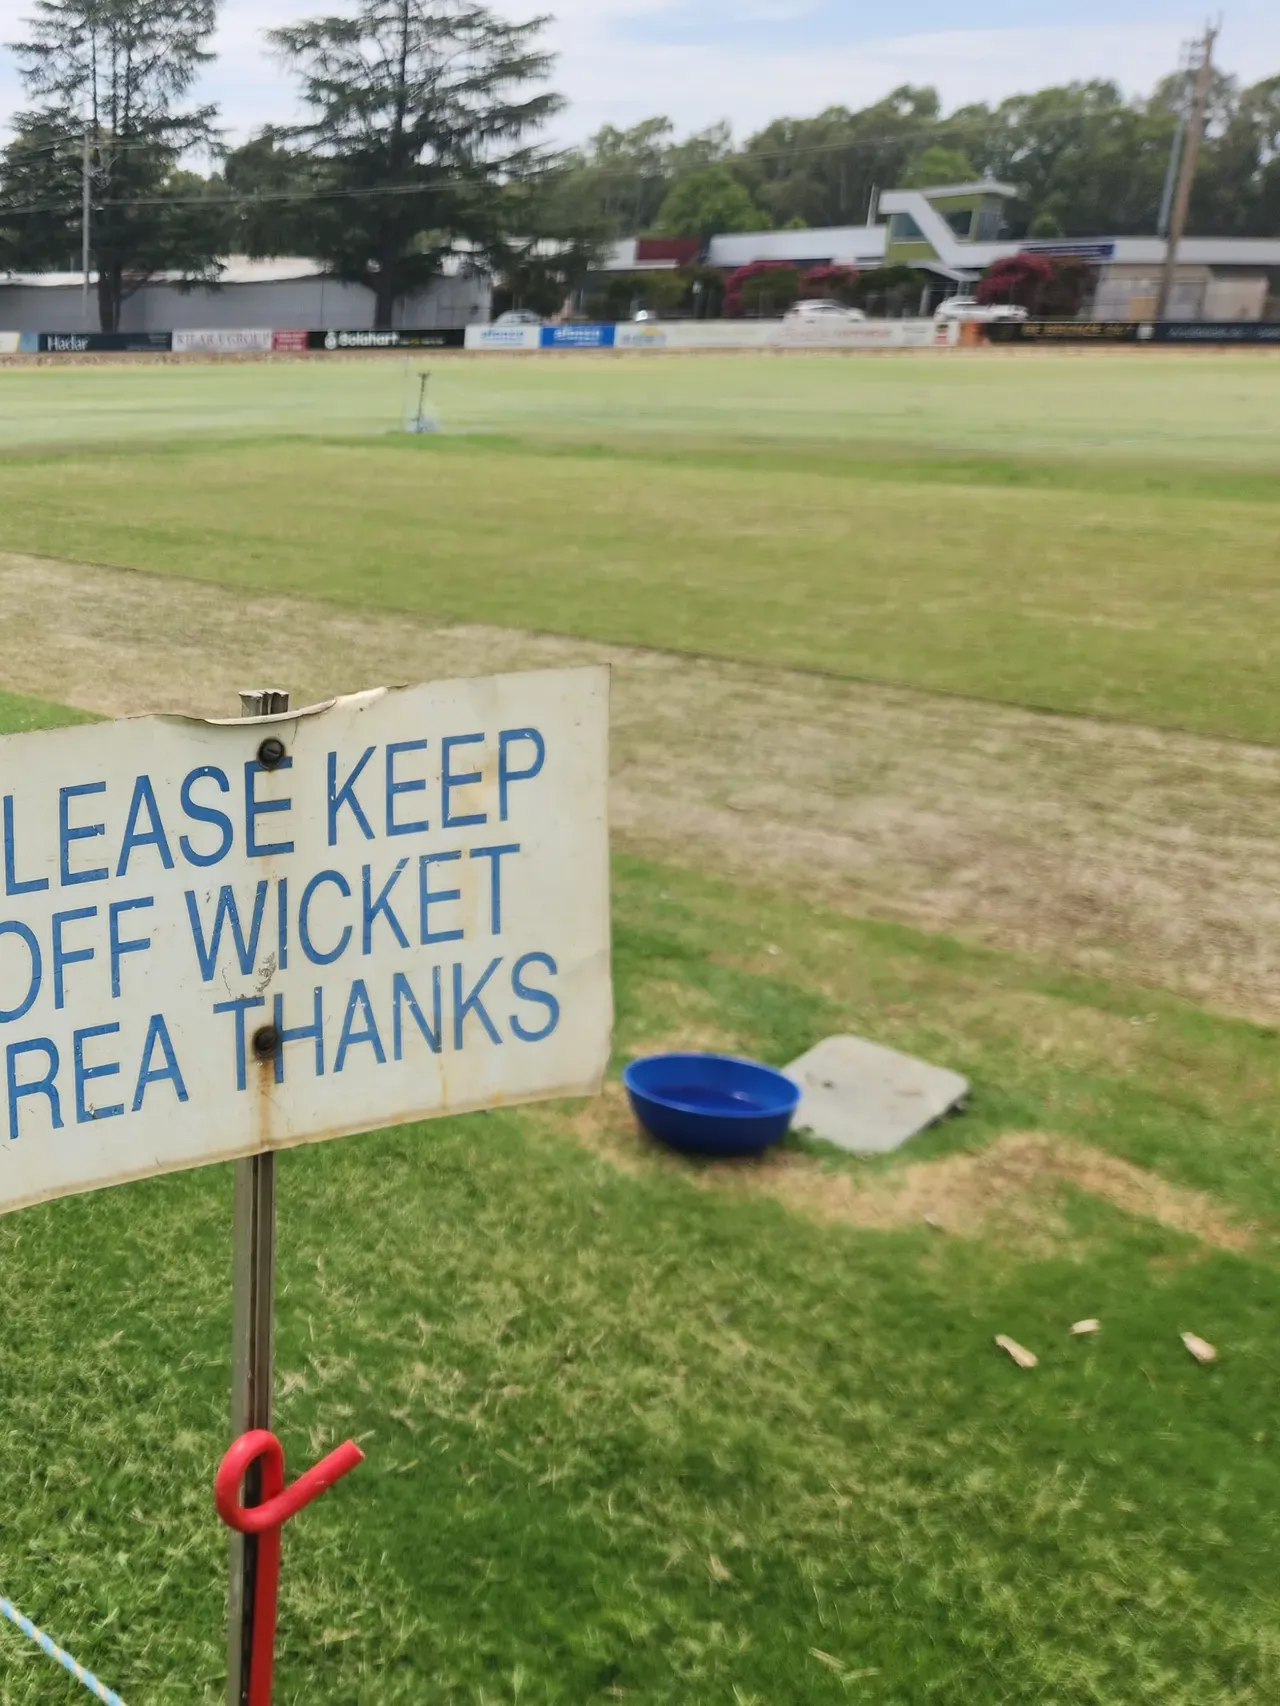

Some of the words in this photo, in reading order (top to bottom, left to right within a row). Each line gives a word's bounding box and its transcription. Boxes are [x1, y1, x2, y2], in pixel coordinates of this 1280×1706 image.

[327, 727, 545, 847] KEEP
[185, 843, 520, 983] WICKET
[212, 952, 560, 1091] THANKS
